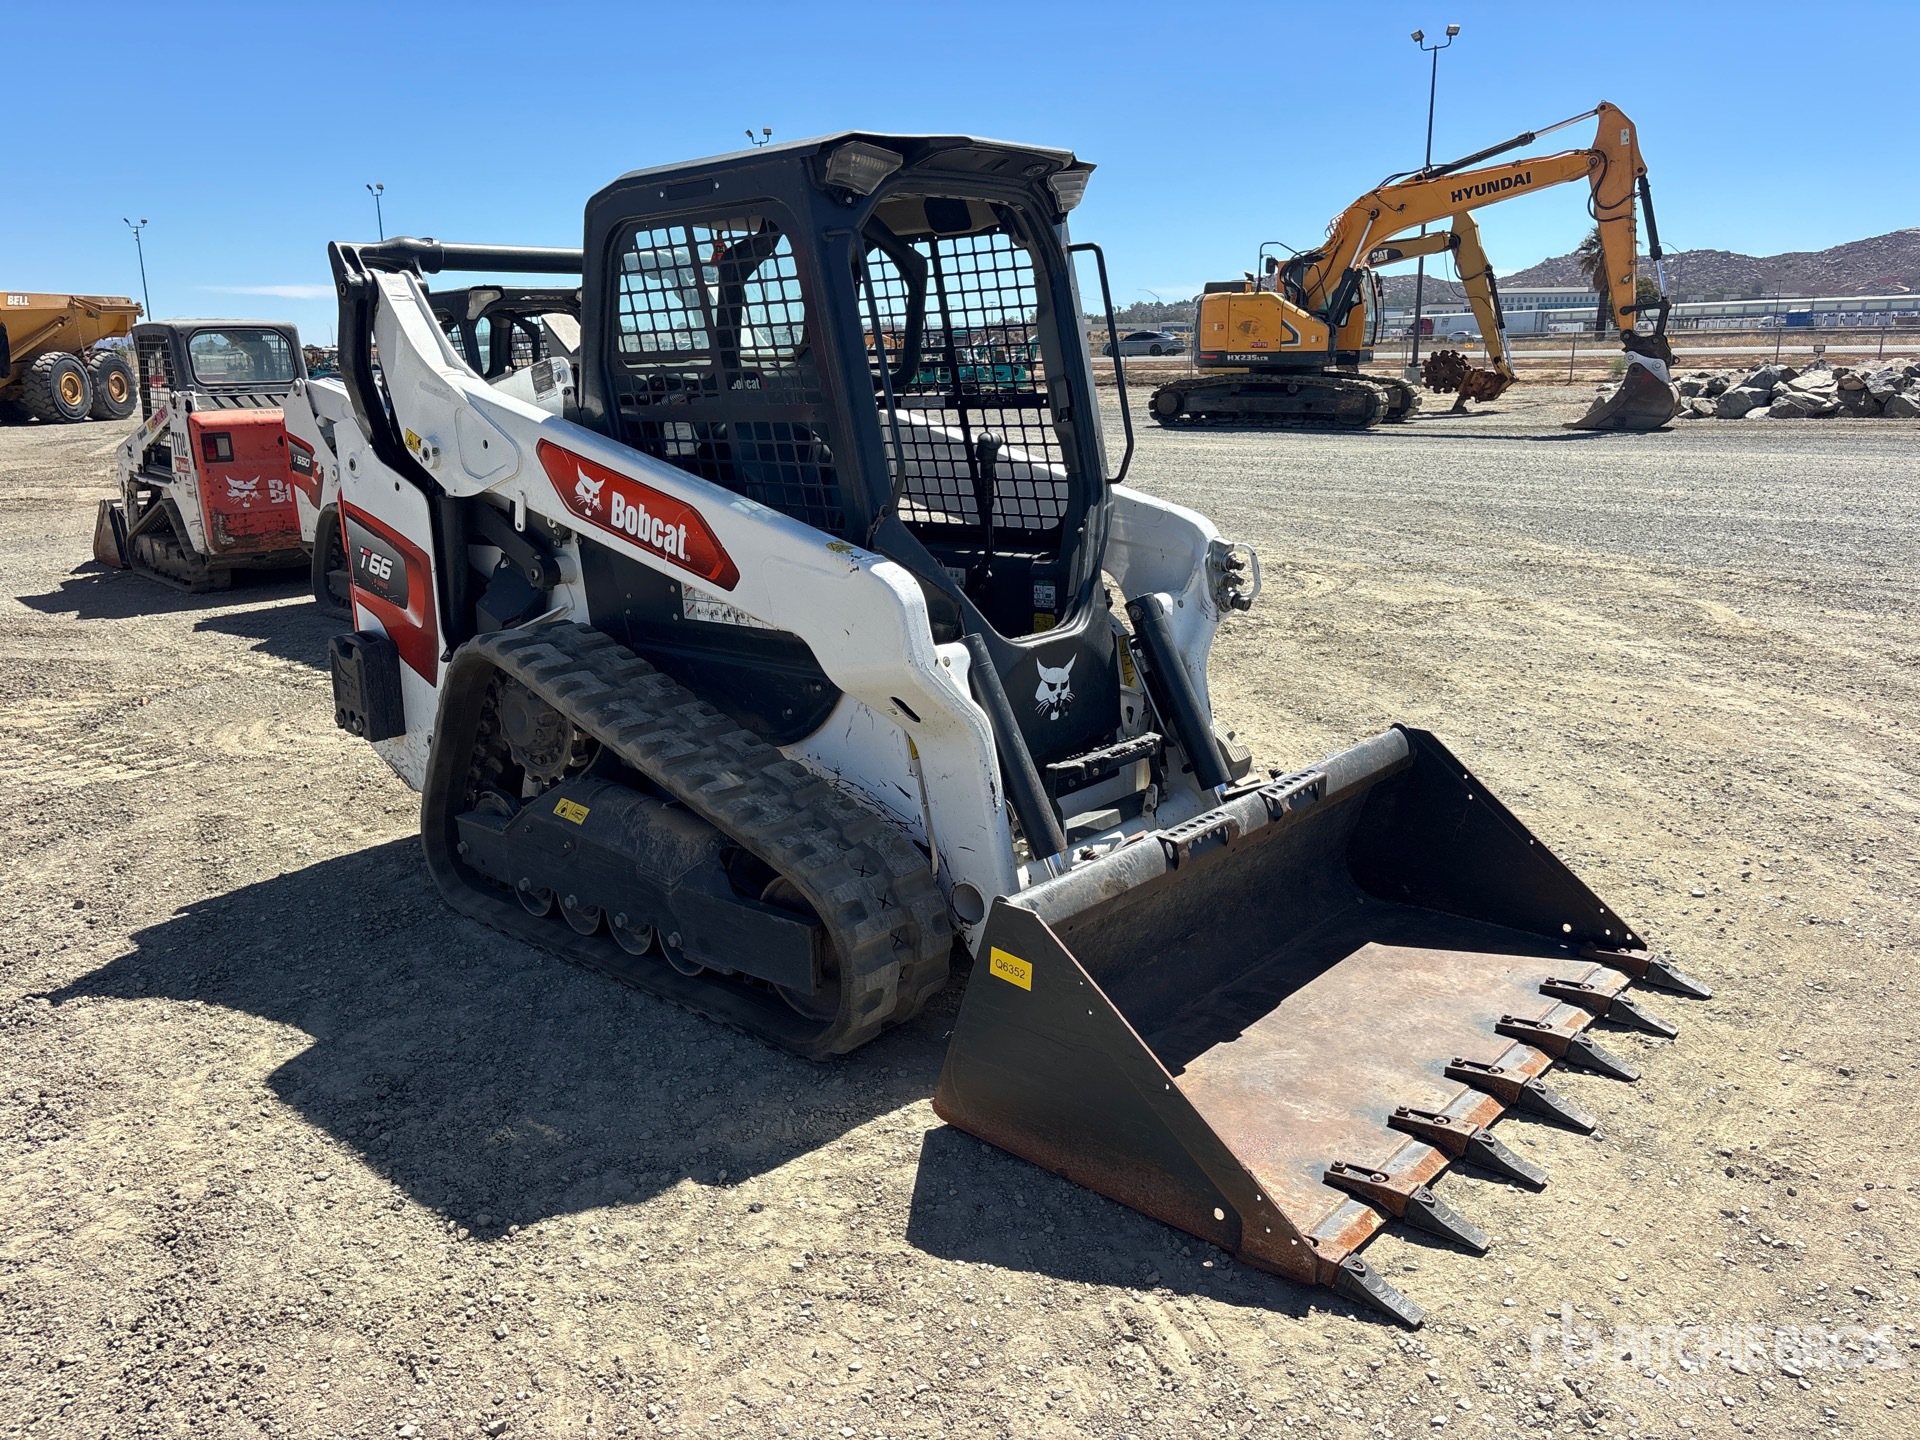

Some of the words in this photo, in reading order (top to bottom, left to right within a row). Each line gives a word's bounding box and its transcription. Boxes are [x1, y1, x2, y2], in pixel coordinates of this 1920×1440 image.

[1450, 171, 1532, 203] HYUNDAI
[1371, 249, 1389, 263] CAT
[7, 295, 30, 306] BELL
[610, 490, 687, 561] Bobcat
[359, 547, 394, 581] T66
[995, 958, 1026, 980] Q6352
